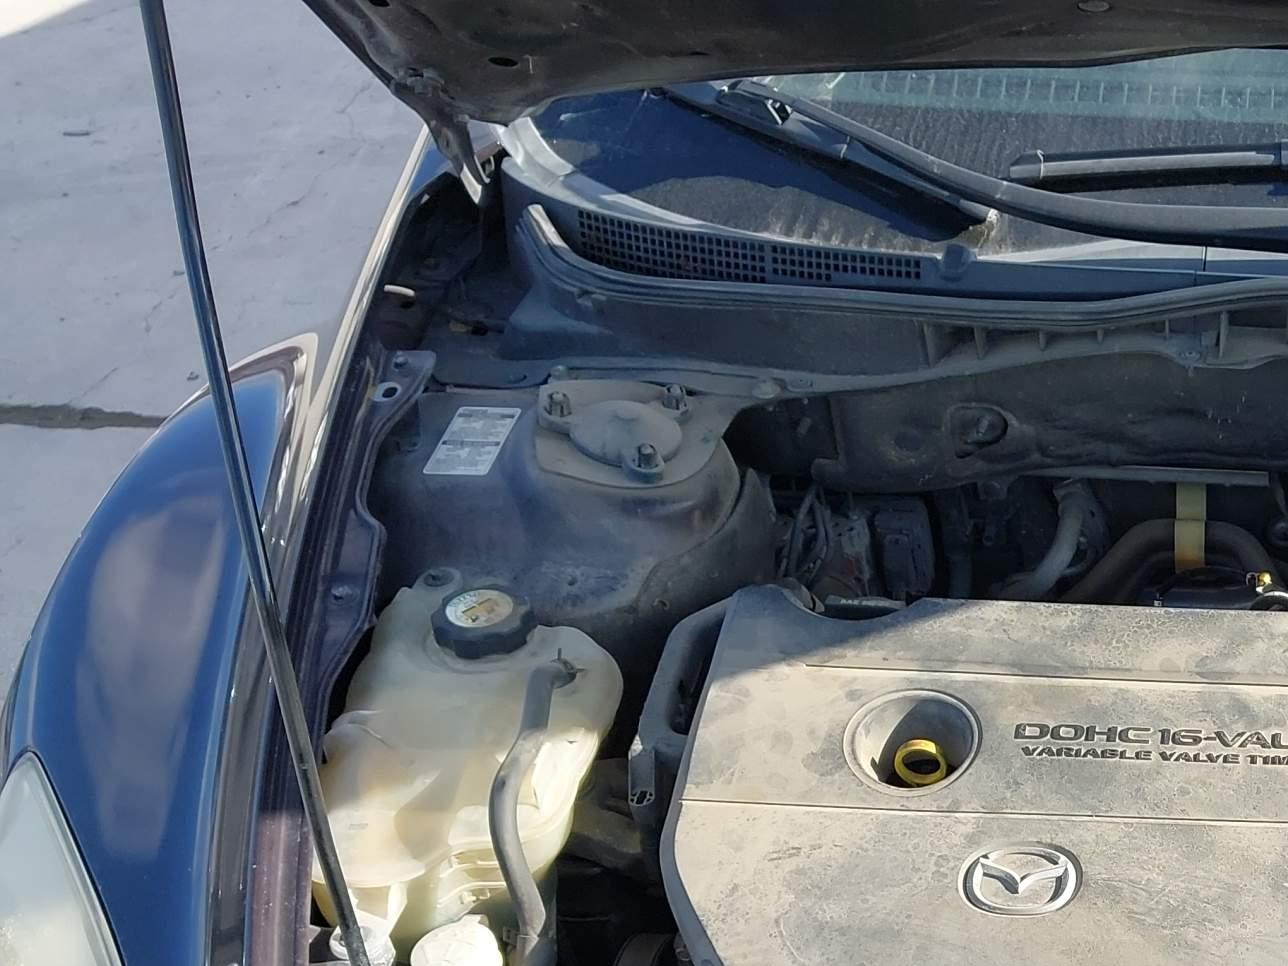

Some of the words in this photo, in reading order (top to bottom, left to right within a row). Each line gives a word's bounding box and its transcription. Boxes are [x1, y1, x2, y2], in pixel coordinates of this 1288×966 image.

[1014, 723, 1151, 744] DOHC
[1021, 746, 1152, 760] VARIABLE
[1159, 751, 1241, 764] VALVE
